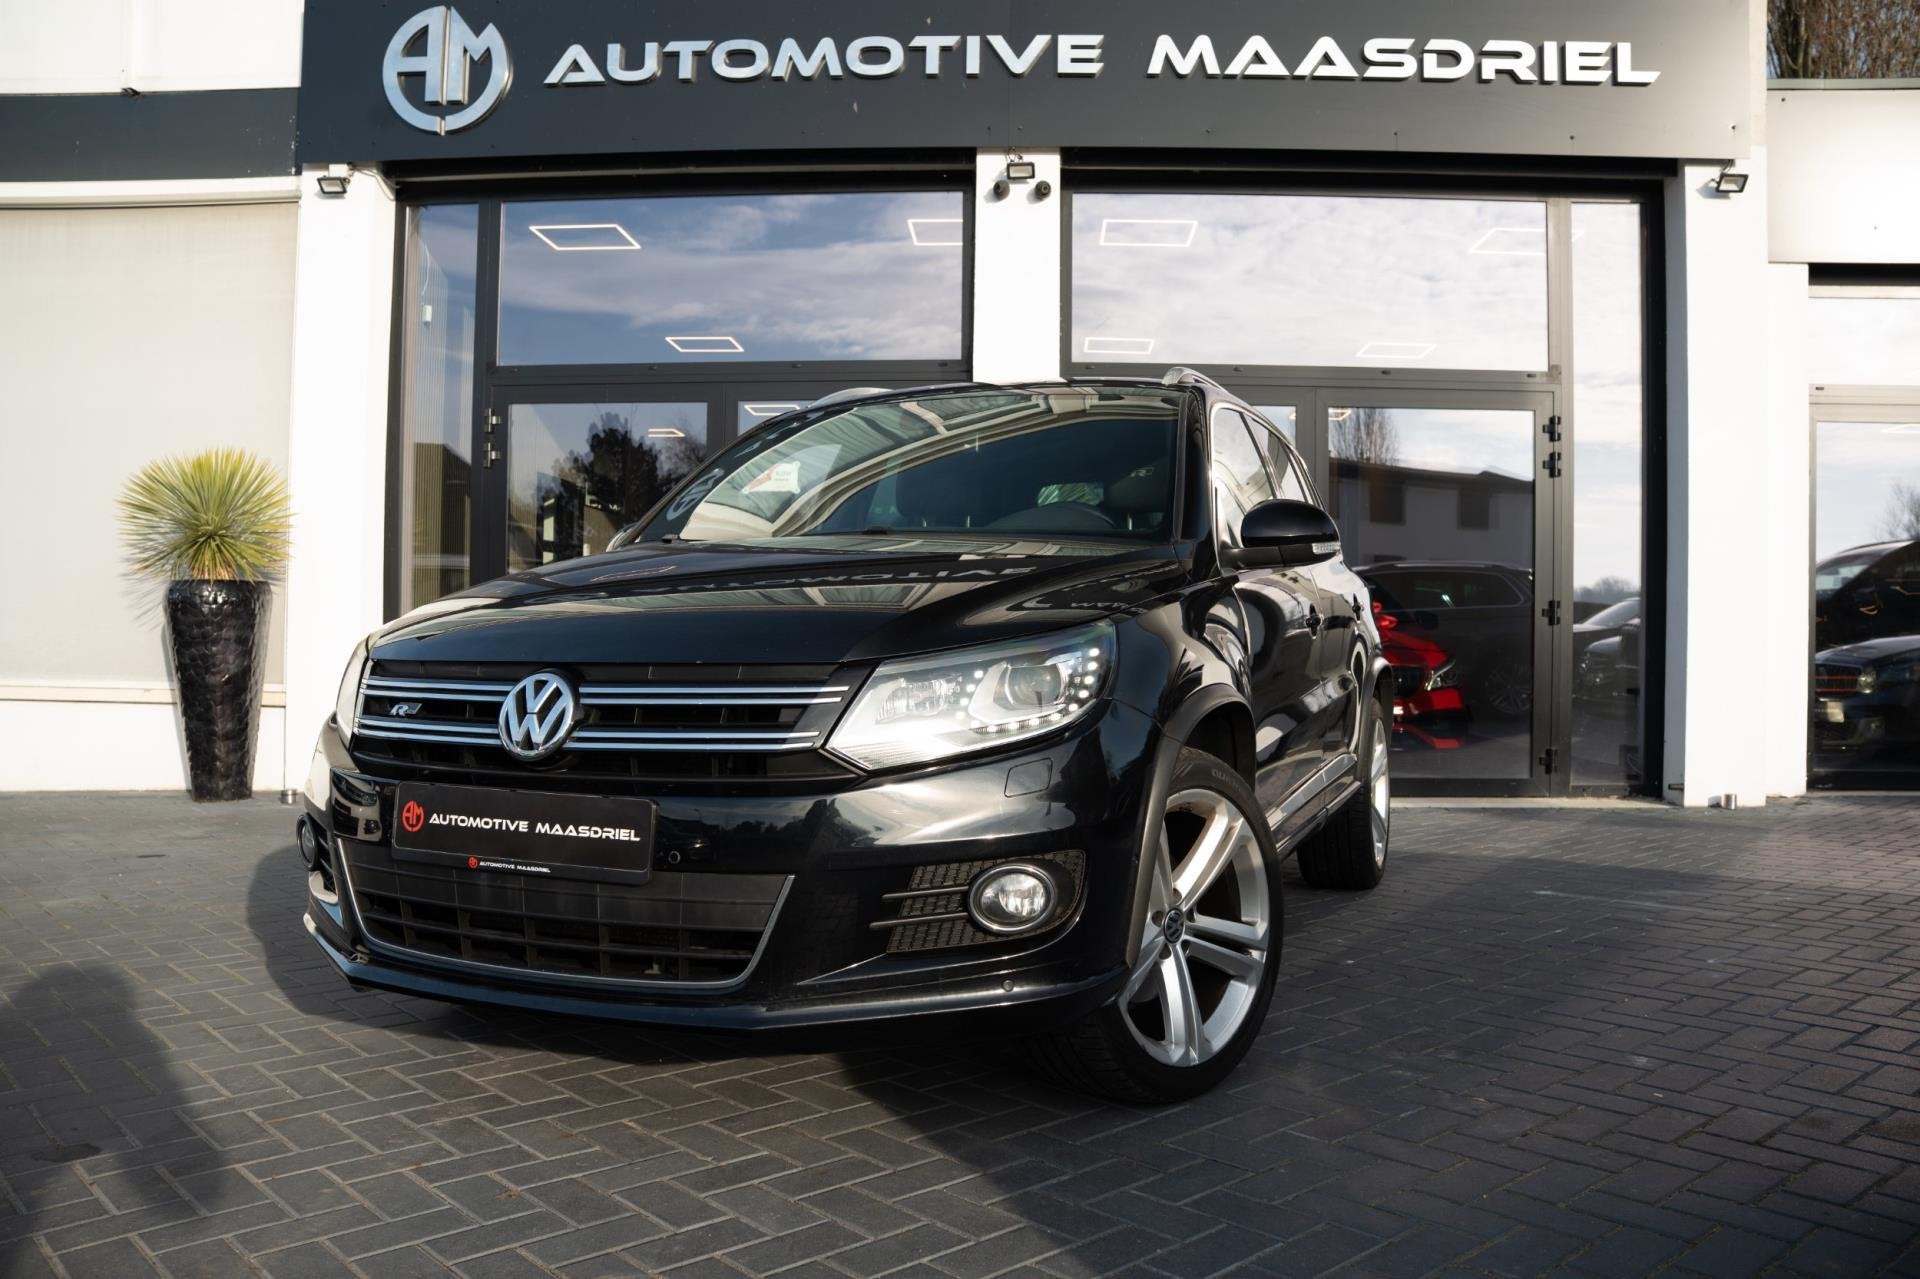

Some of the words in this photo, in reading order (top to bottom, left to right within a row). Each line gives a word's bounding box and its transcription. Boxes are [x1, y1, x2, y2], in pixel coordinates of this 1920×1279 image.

[544, 35, 1105, 84] AUTOMOTIVE
[1146, 35, 1660, 86] MAASDRIEL
[429, 813, 529, 832] AUTOMOTIVE
[535, 823, 641, 842] MAASDRIEL
[480, 861, 515, 869] AUTOMOTIVE
